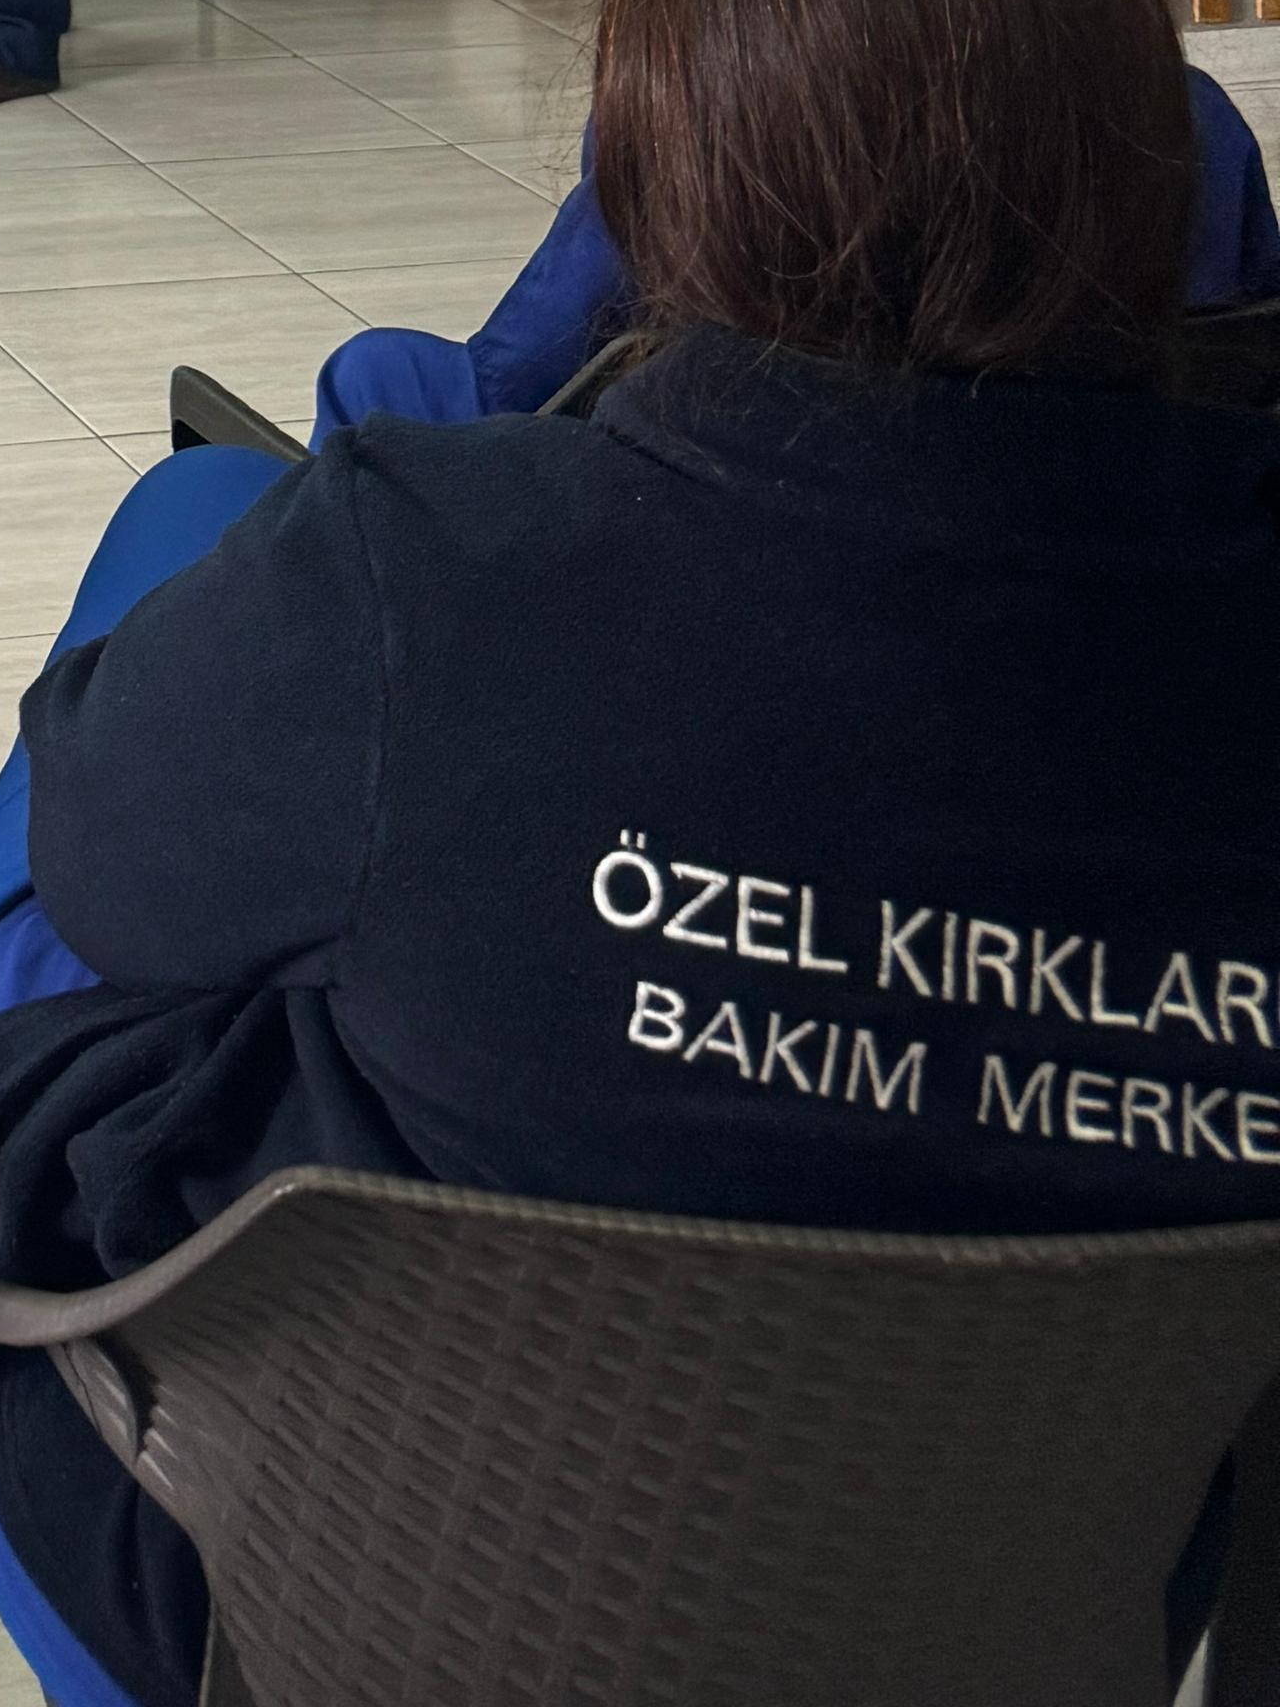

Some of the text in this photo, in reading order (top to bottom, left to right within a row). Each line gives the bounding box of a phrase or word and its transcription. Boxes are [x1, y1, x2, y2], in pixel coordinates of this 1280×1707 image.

[592, 829, 1280, 1051] ÖZEL KIRKLAR
[627, 981, 1280, 1165] BAKIM MERKE
